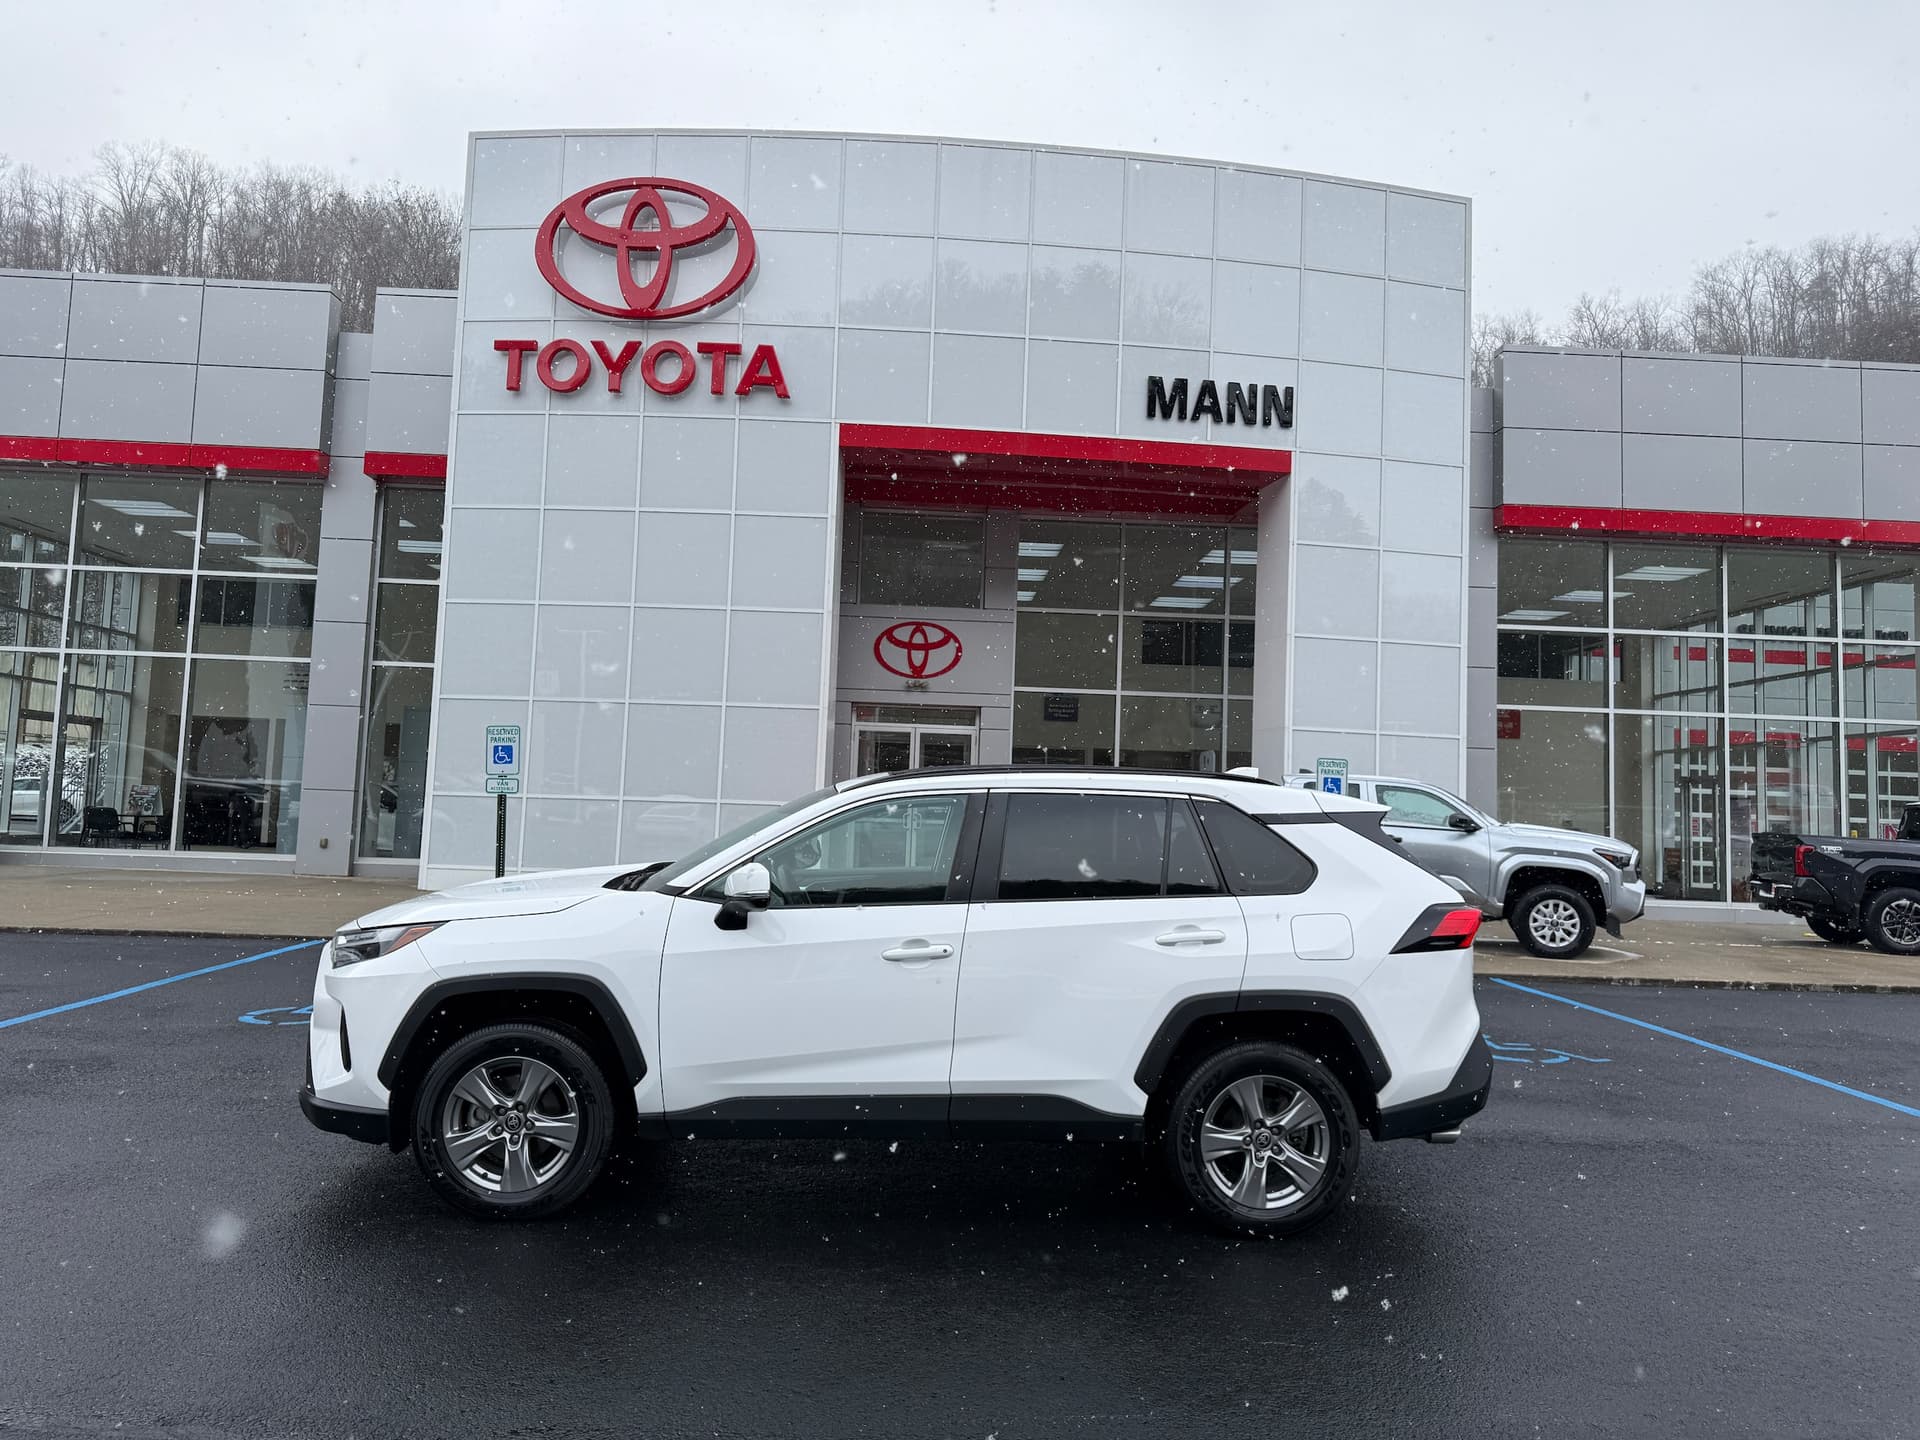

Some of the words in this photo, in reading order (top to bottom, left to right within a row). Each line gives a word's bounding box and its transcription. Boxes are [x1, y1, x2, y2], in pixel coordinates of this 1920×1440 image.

[494, 338, 791, 399] TOYOTA
[1147, 376, 1294, 428] MANN
[488, 728, 519, 736] RESERVED
[490, 736, 516, 744] PARKING
[1318, 760, 1347, 768] RESERVED
[1320, 768, 1344, 776] PARKING
